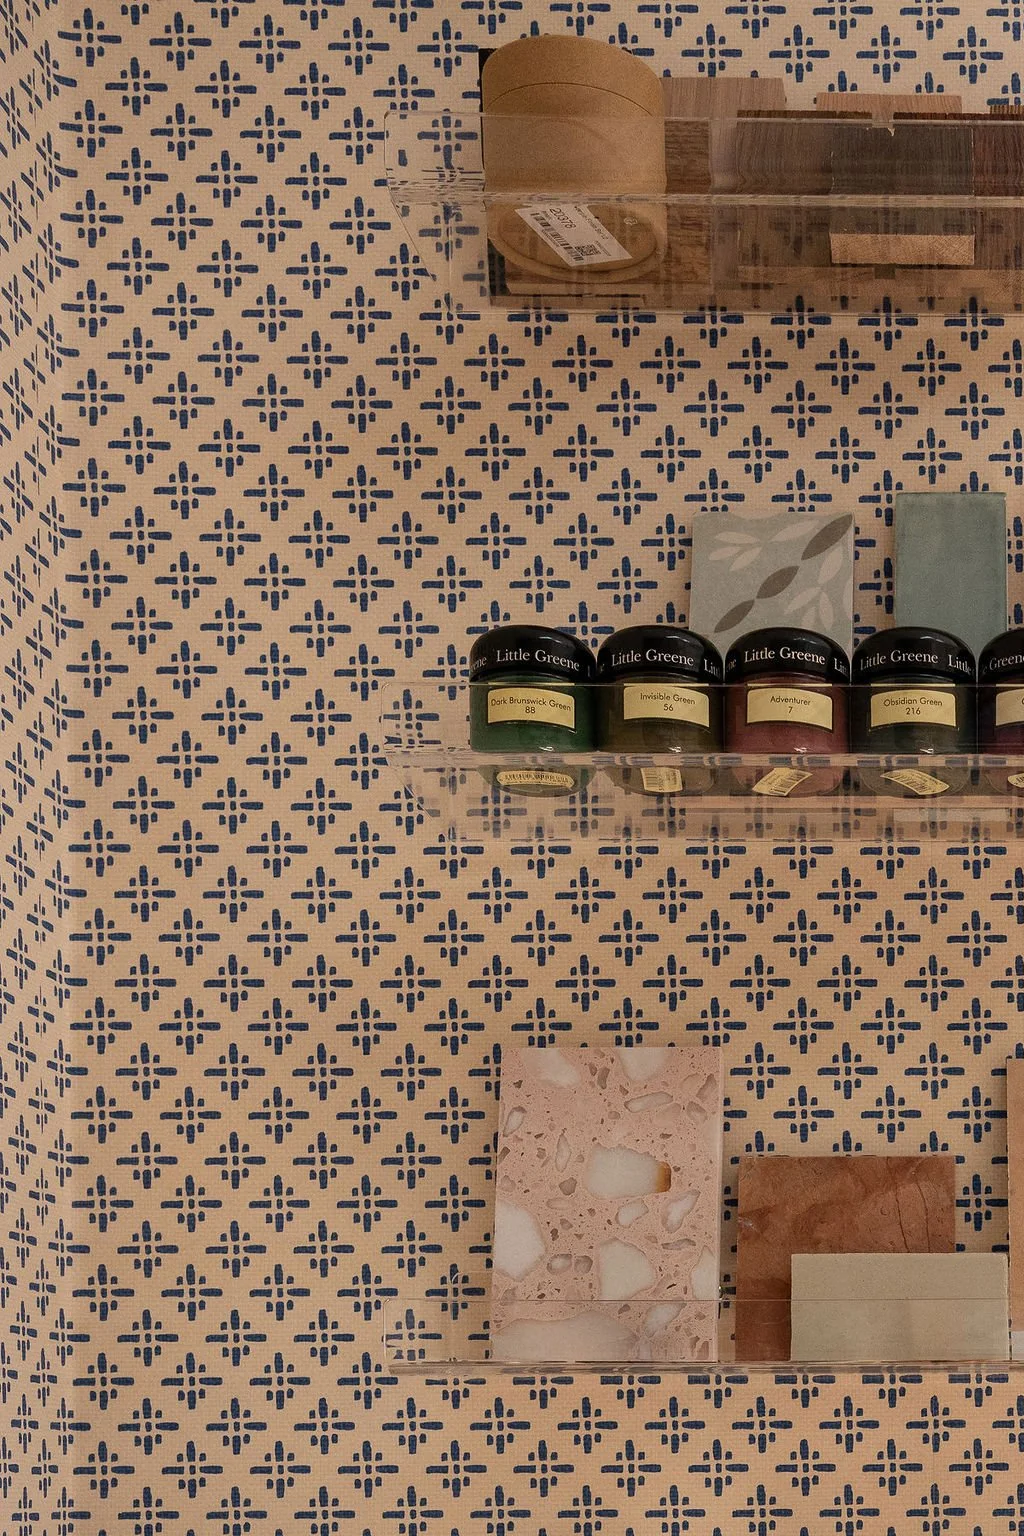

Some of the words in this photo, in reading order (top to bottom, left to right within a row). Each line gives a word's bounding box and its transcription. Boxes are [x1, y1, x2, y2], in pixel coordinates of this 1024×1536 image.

[496, 648, 531, 663] Little
[534, 649, 581, 672] Greene
[611, 650, 642, 667] Little
[645, 648, 695, 666] Greene
[744, 647, 776, 663] Little
[779, 646, 826, 666] Greene
[860, 652, 887, 673] Little
[890, 649, 939, 665] Greene
[490, 697, 508, 707] Dark
[509, 696, 547, 706] Brunswick
[548, 699, 572, 712] Green
[640, 692, 671, 701] Invisible
[672, 693, 696, 705] Green
[770, 695, 811, 706] Adventurer
[883, 697, 918, 707] Obsidian
[919, 696, 943, 707] Green
[663, 703, 674, 711] 56
[788, 706, 793, 714] 7
[905, 707, 921, 715] 216
